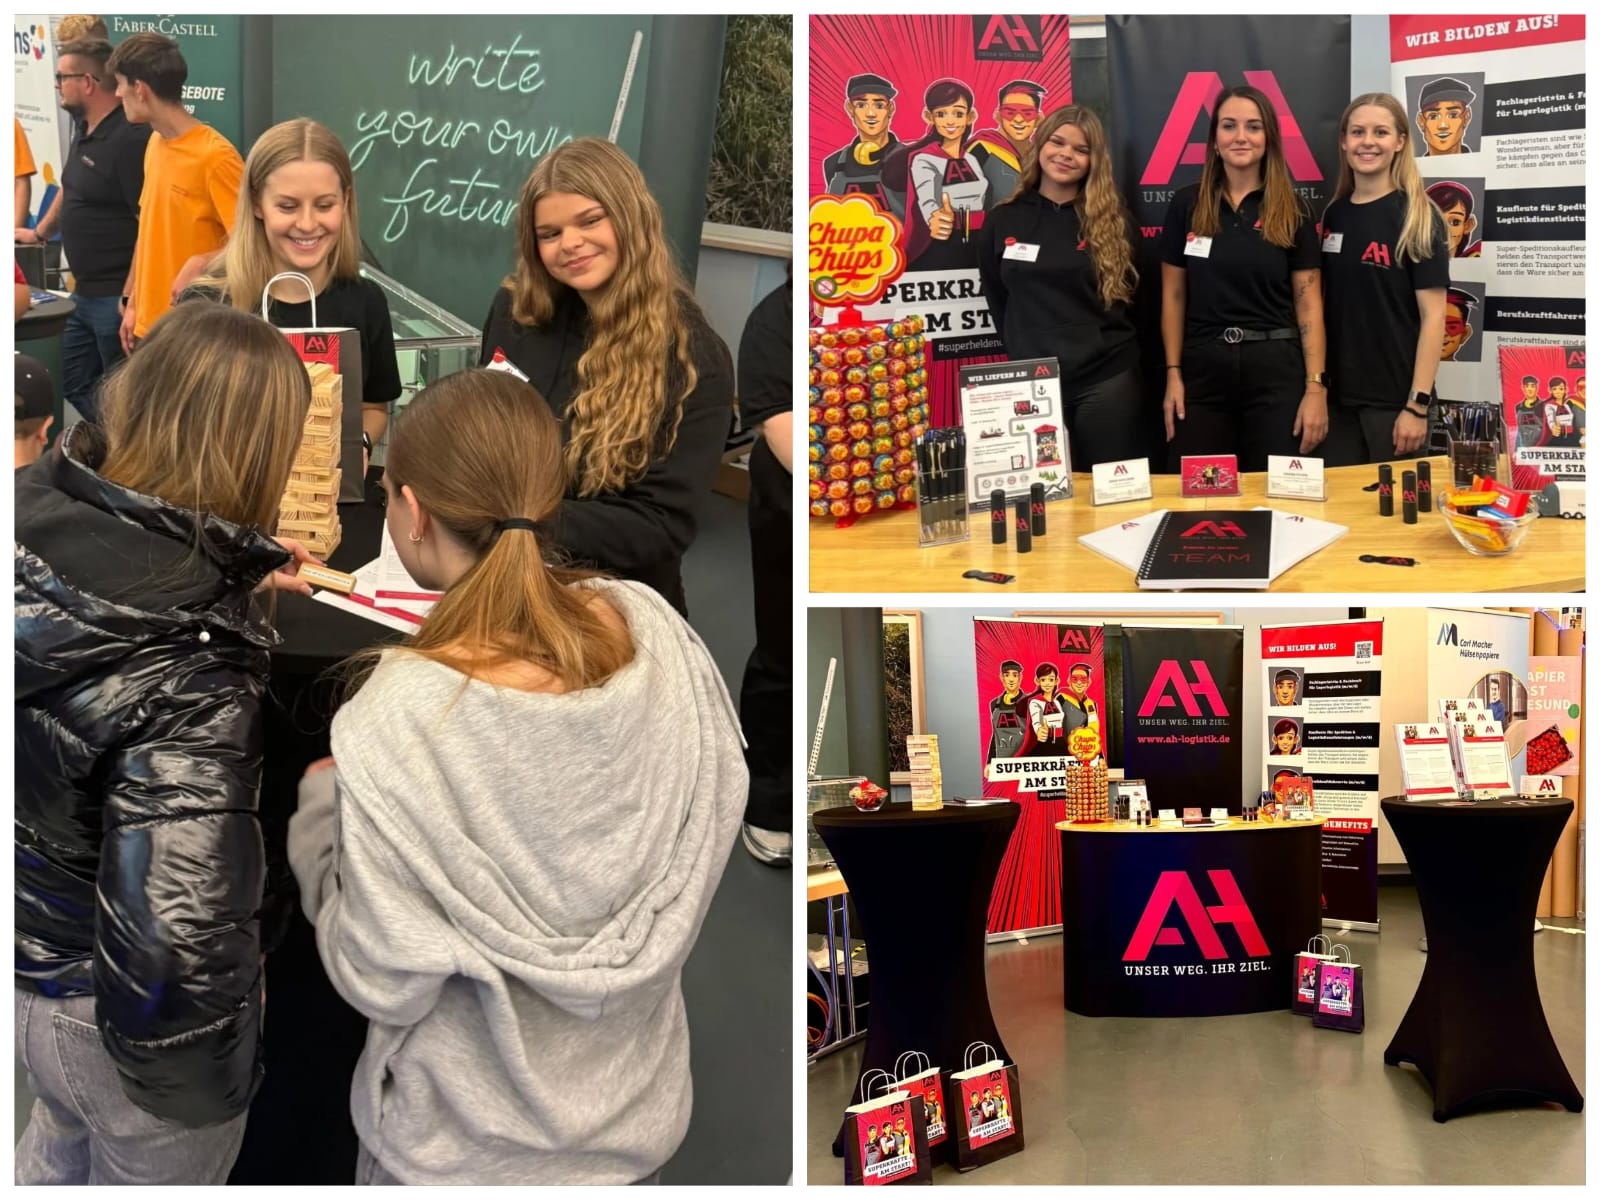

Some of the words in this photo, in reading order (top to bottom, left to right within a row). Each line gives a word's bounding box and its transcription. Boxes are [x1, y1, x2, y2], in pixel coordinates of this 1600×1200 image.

[114, 17, 217, 36] FABER-CASTELL
[978, 14, 1039, 51] AH
[1405, 31, 1440, 47] WIR
[1445, 21, 1510, 42] BILDEN
[1515, 14, 1559, 32] AUS!
[408, 35, 545, 93] write
[1512, 104, 1572, 116] Lagerlogistik
[350, 111, 480, 171] your
[1496, 137, 1549, 146] Fachlageristen
[1509, 153, 1539, 161] kämpfen
[1541, 152, 1563, 160] gegen
[946, 161, 978, 183] AH
[382, 159, 519, 242] futur
[1496, 205, 1538, 213] Kaufleute
[809, 222, 886, 251] Chupa
[809, 247, 882, 274] Chups
[1361, 241, 1391, 266] AH
[1535, 261, 1572, 269] Transport
[880, 279, 985, 304] PERKR
[305, 336, 327, 350] AH
[938, 338, 1004, 353] #superhelden
[1497, 336, 1560, 345] Berufskraftfahrer
[1035, 365, 1050, 376] AH
[1289, 459, 1303, 470] AH
[1544, 464, 1562, 473] AM
[1180, 520, 1247, 537] AH
[1168, 553, 1251, 563] TEAM
[1060, 629, 1089, 648] AH
[1460, 638, 1471, 647] Carl
[1472, 640, 1493, 649] Macher
[1268, 645, 1285, 653] WIR
[1286, 644, 1316, 652] BILDEN
[1460, 649, 1500, 660] Hülsenpapiere
[1137, 659, 1230, 717] AH
[997, 713, 1019, 728] AH
[1137, 734, 1230, 745] www.ah-logistik.de
[1024, 777, 1047, 788] AM
[1539, 778, 1556, 791] AH
[1323, 820, 1369, 830] BENEFITS
[1121, 869, 1271, 961] AH
[1125, 965, 1170, 976] UNSER
[1174, 965, 1208, 975] WEG.
[1212, 963, 1236, 974] IHR
[1239, 960, 1271, 973] ZIEL.
